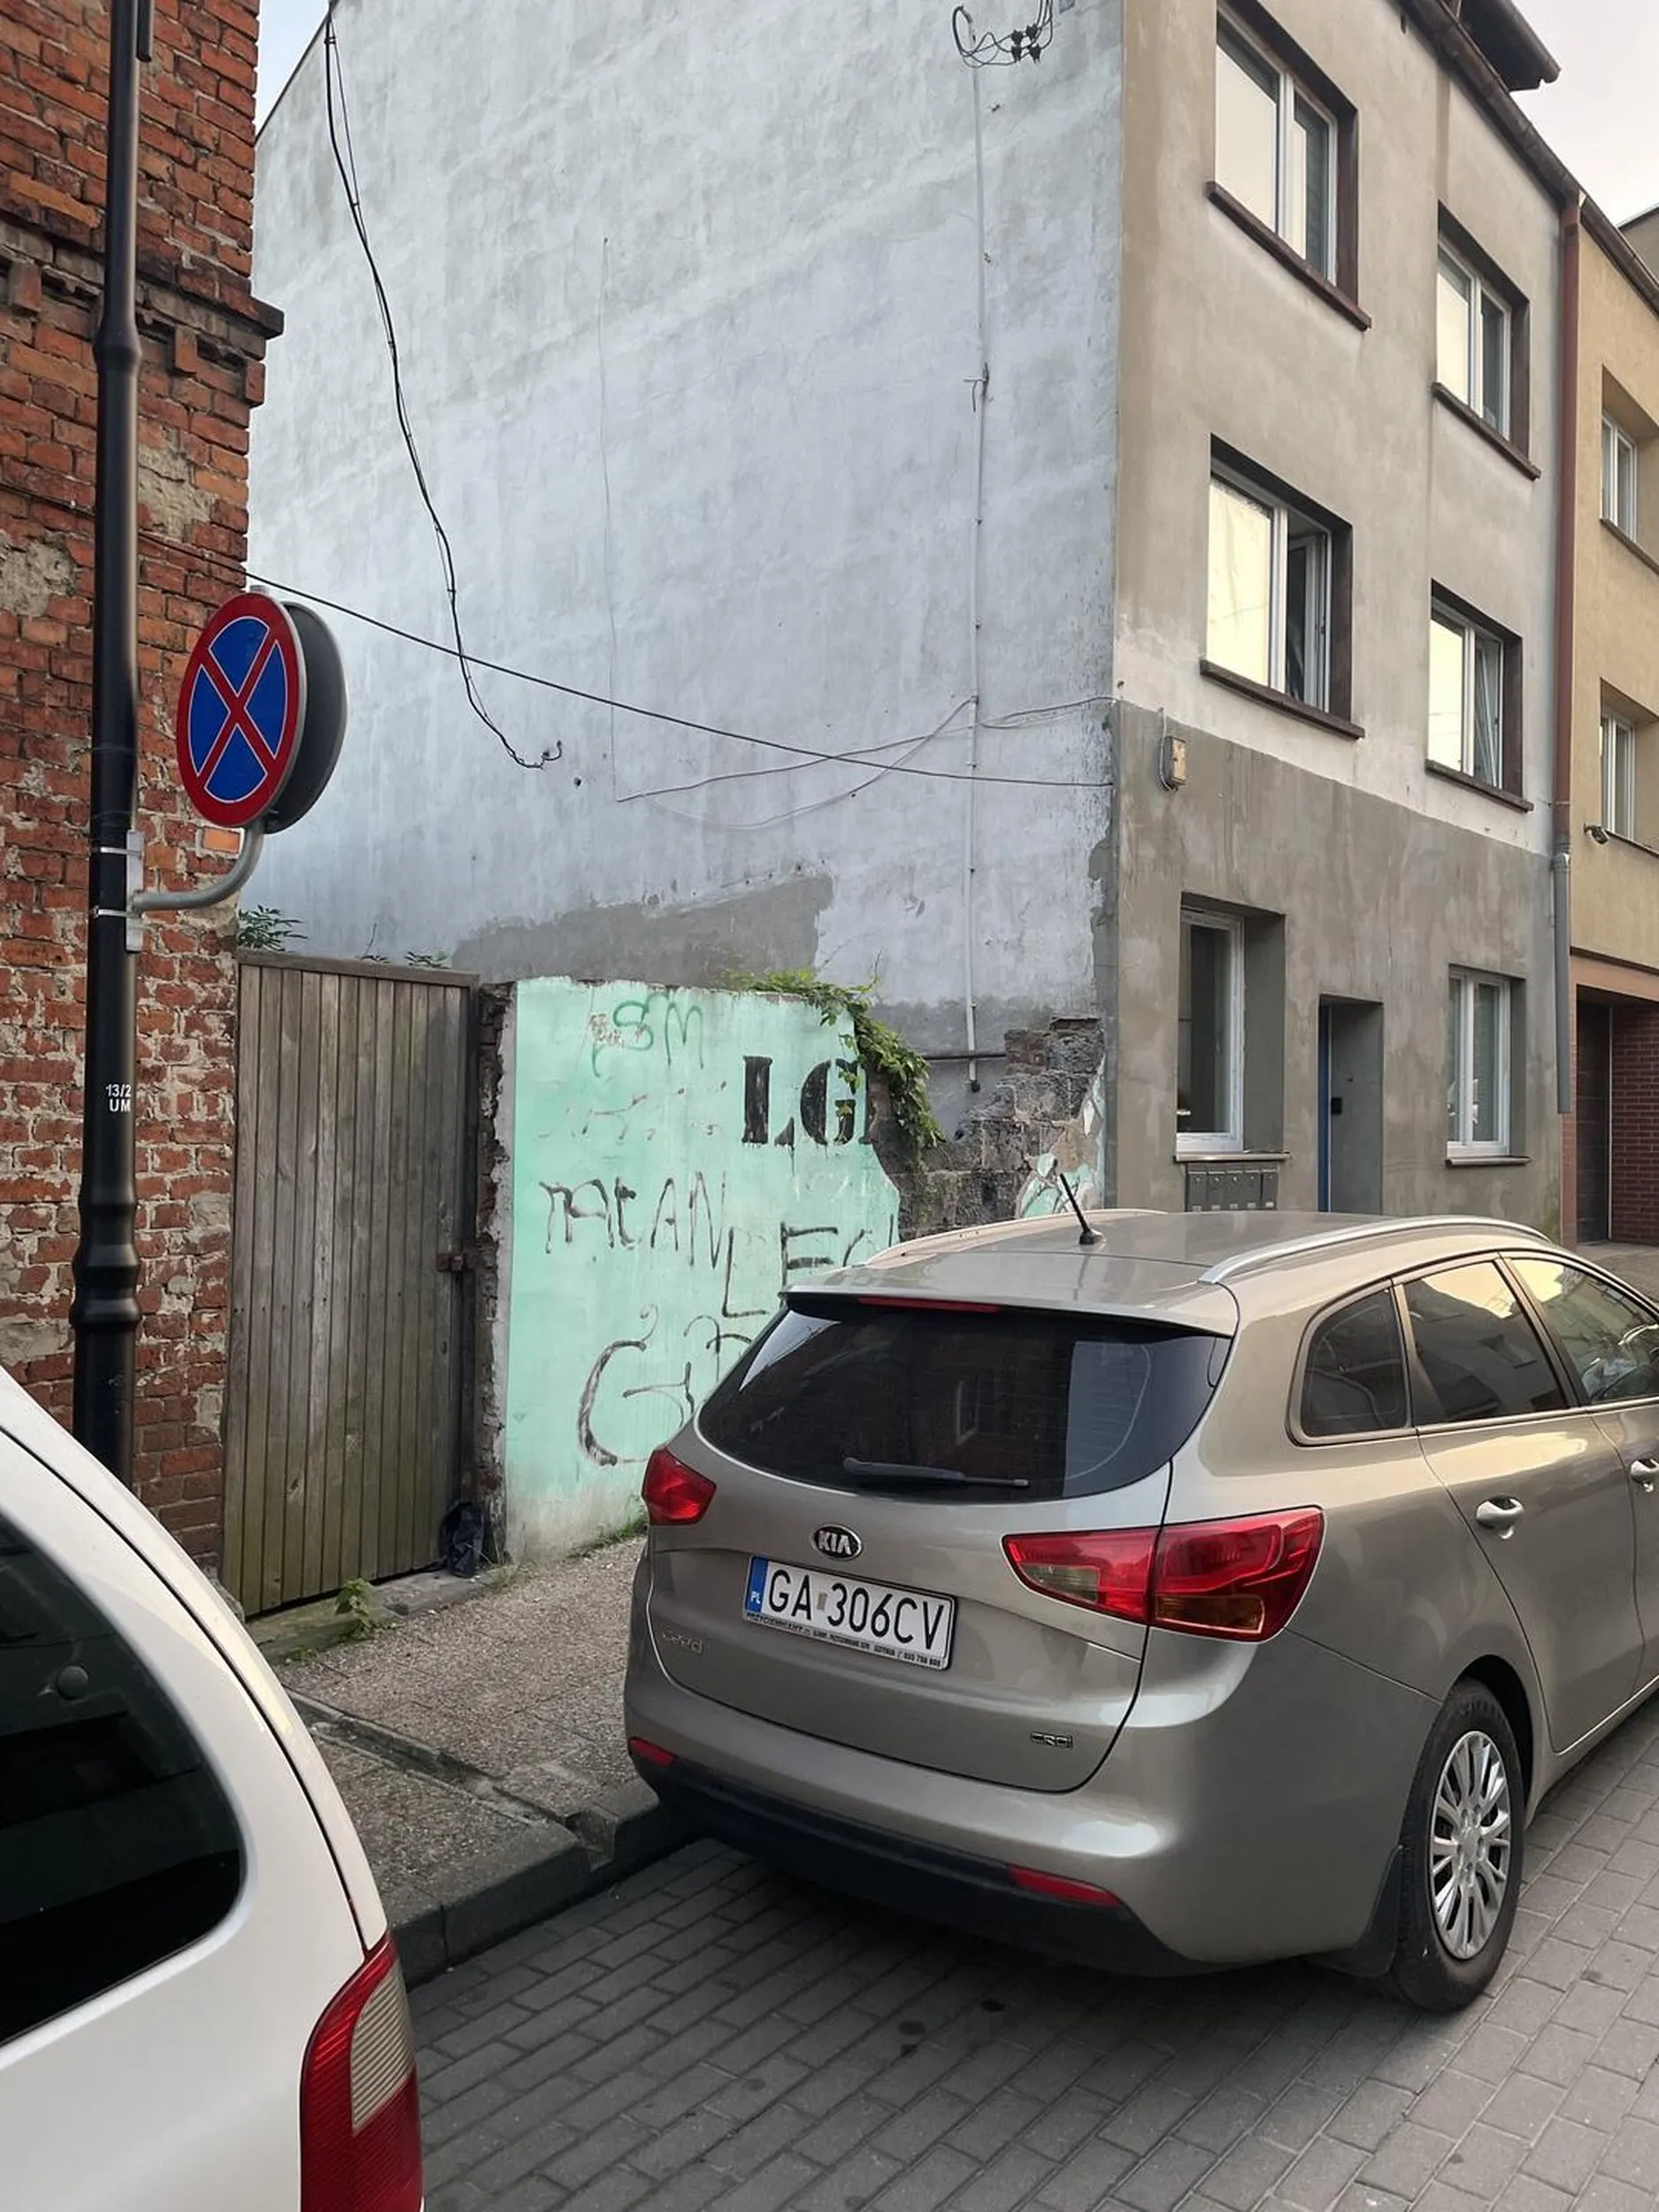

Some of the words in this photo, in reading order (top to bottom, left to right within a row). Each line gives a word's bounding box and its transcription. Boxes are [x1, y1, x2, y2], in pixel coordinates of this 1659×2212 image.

[106, 1083, 132, 1097] 13/2
[109, 1098, 131, 1112] UM
[818, 1530, 852, 1555] KIA
[751, 1591, 762, 1604] PL
[769, 1570, 812, 1621] GA
[827, 1582, 944, 1650] 306CV
